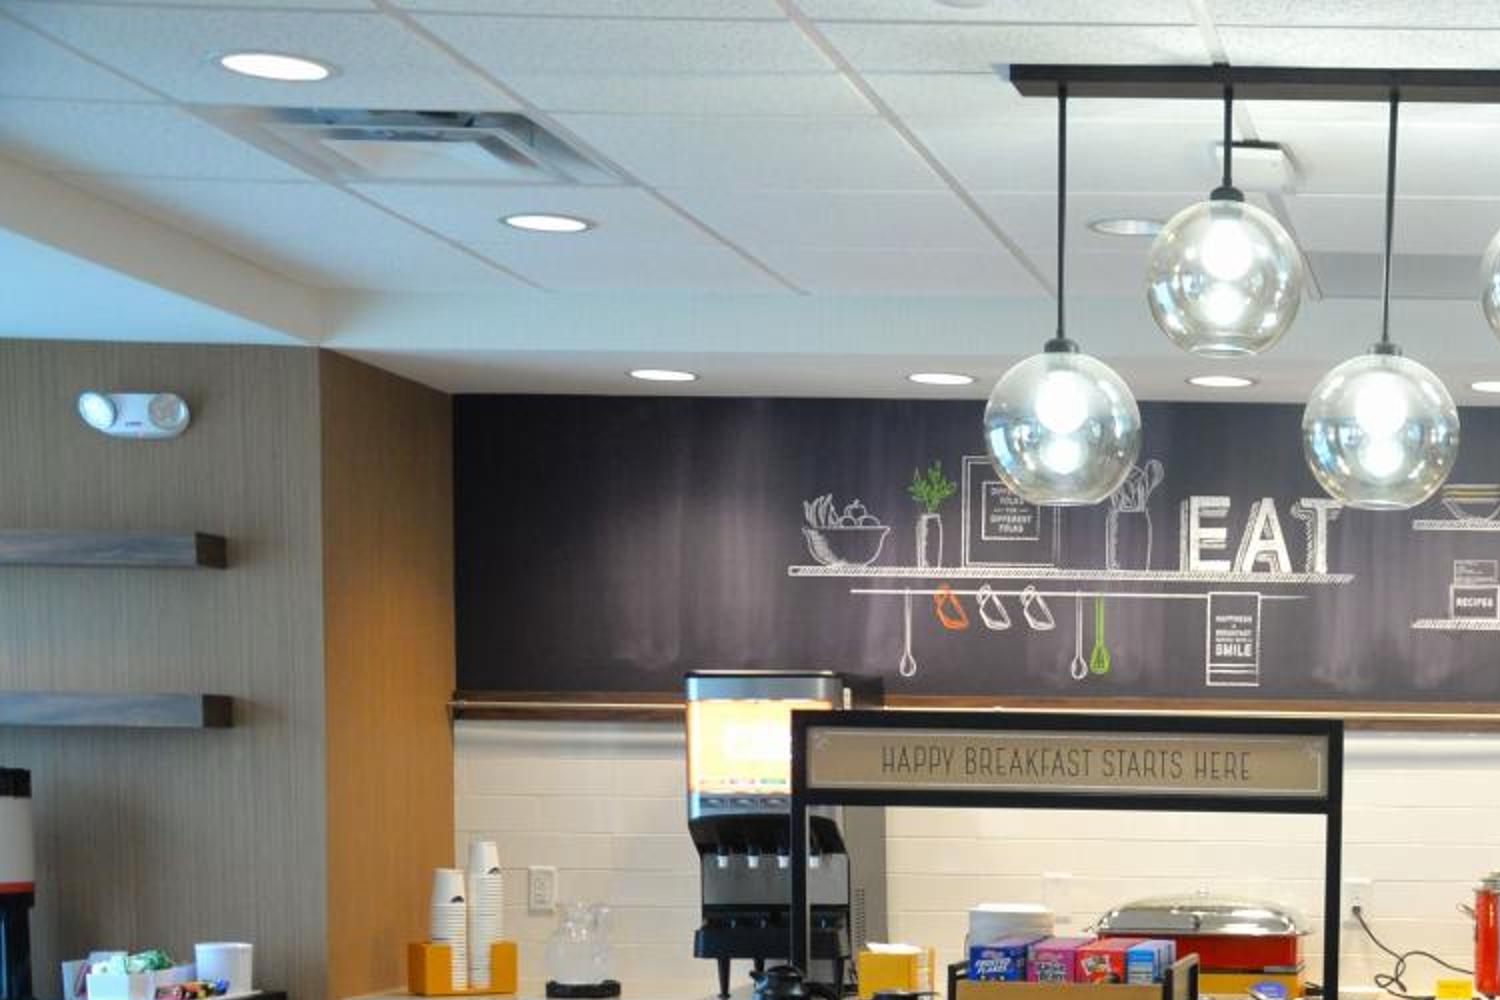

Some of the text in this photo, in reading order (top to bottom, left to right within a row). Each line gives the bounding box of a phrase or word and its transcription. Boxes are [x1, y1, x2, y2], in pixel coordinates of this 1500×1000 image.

[1182, 496, 1343, 574] EAT
[1215, 643, 1253, 657] SMILE
[881, 745, 1252, 782] HAPPY BREAKFAST STARTS HERE
